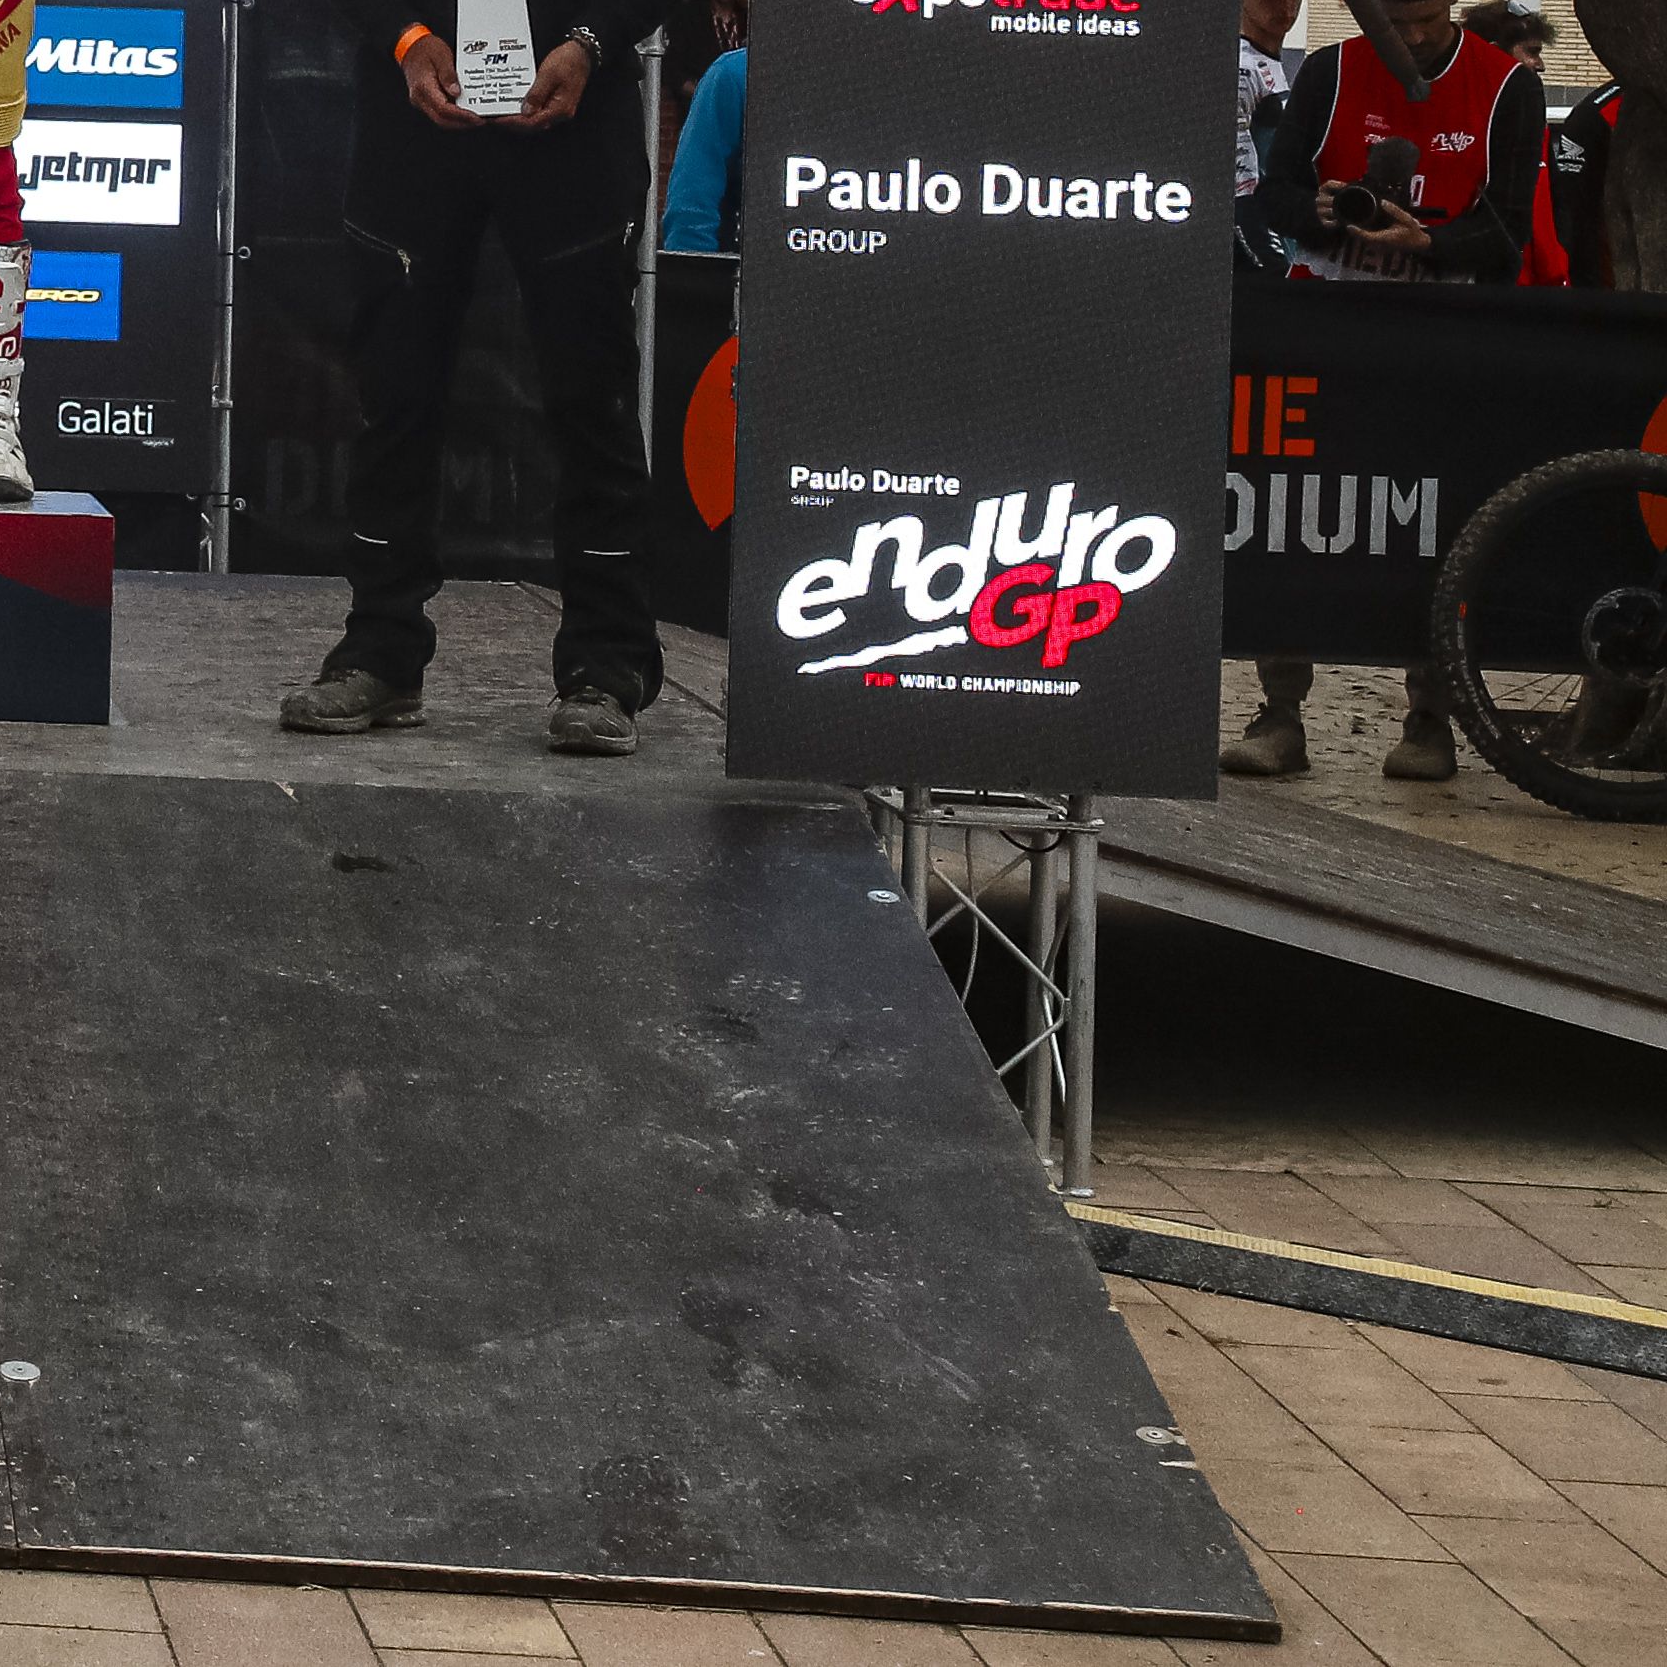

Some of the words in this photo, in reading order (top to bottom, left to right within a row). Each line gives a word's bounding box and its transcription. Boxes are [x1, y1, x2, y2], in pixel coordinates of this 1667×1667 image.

[990, 13, 1072, 34] mobile
[1077, 13, 1140, 37] ideas
[482, 54, 508, 65] FIM
[784, 155, 962, 215] Paulo
[981, 163, 1192, 223] Duarte
[787, 227, 888, 254] GROUP
[58, 401, 154, 435] Galati
[789, 465, 866, 492] Paulo
[871, 468, 960, 496] Duarte
[969, 563, 1122, 668] GP
[900, 674, 956, 691] WORLD
